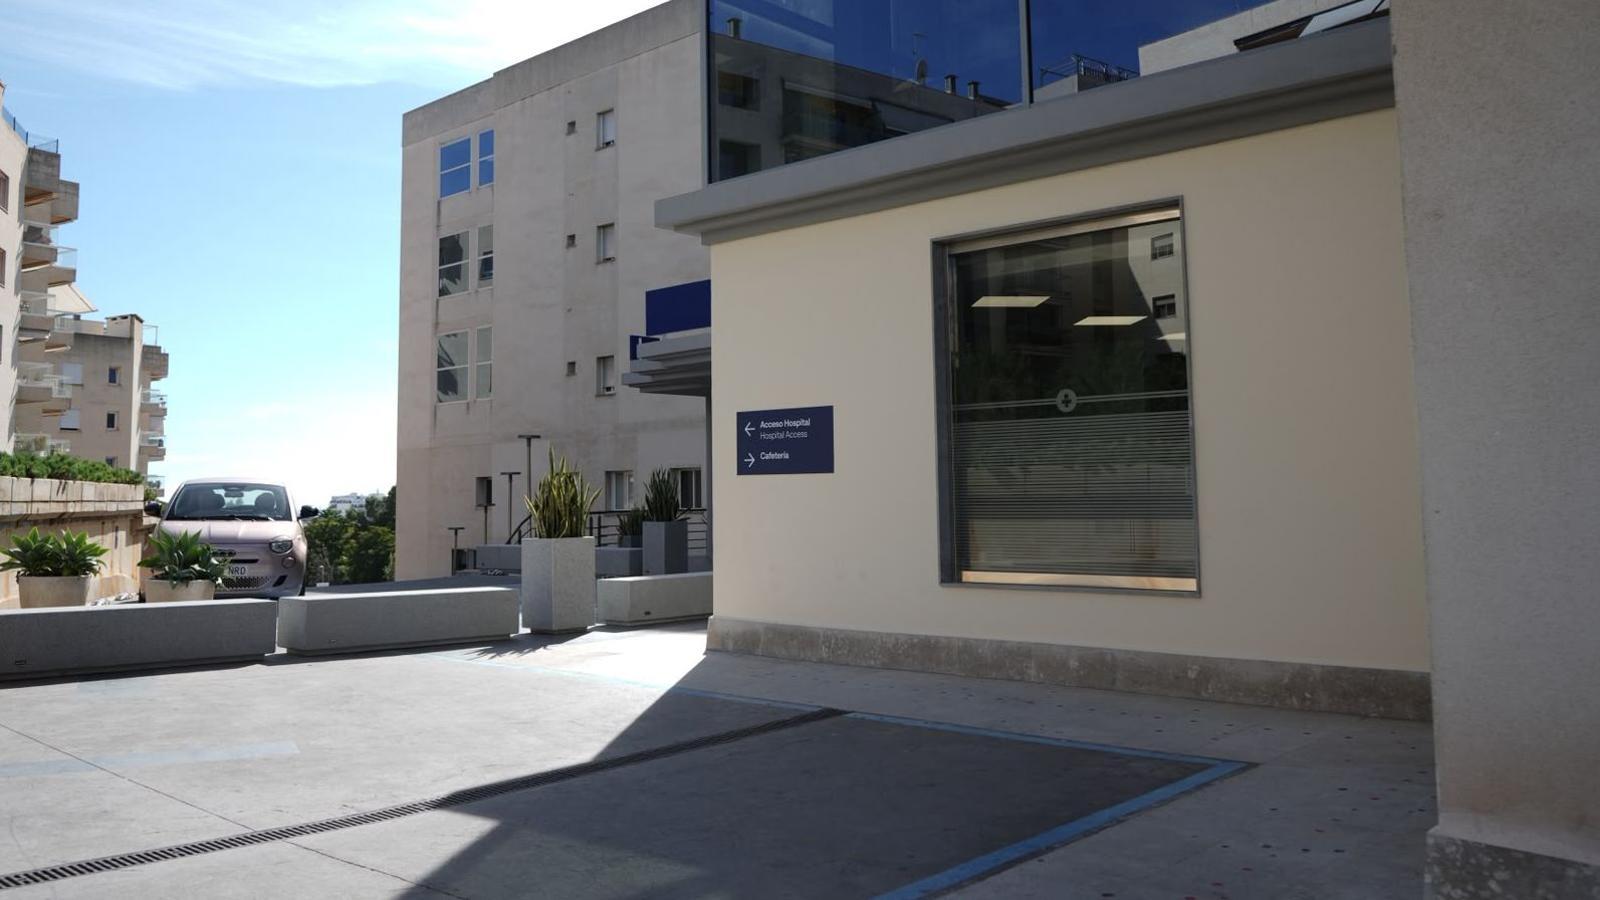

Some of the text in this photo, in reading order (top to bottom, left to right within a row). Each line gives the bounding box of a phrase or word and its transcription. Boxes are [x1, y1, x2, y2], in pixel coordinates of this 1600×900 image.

[760, 418, 811, 428] Acceso Hospital
[760, 430, 808, 440] Hospital Access
